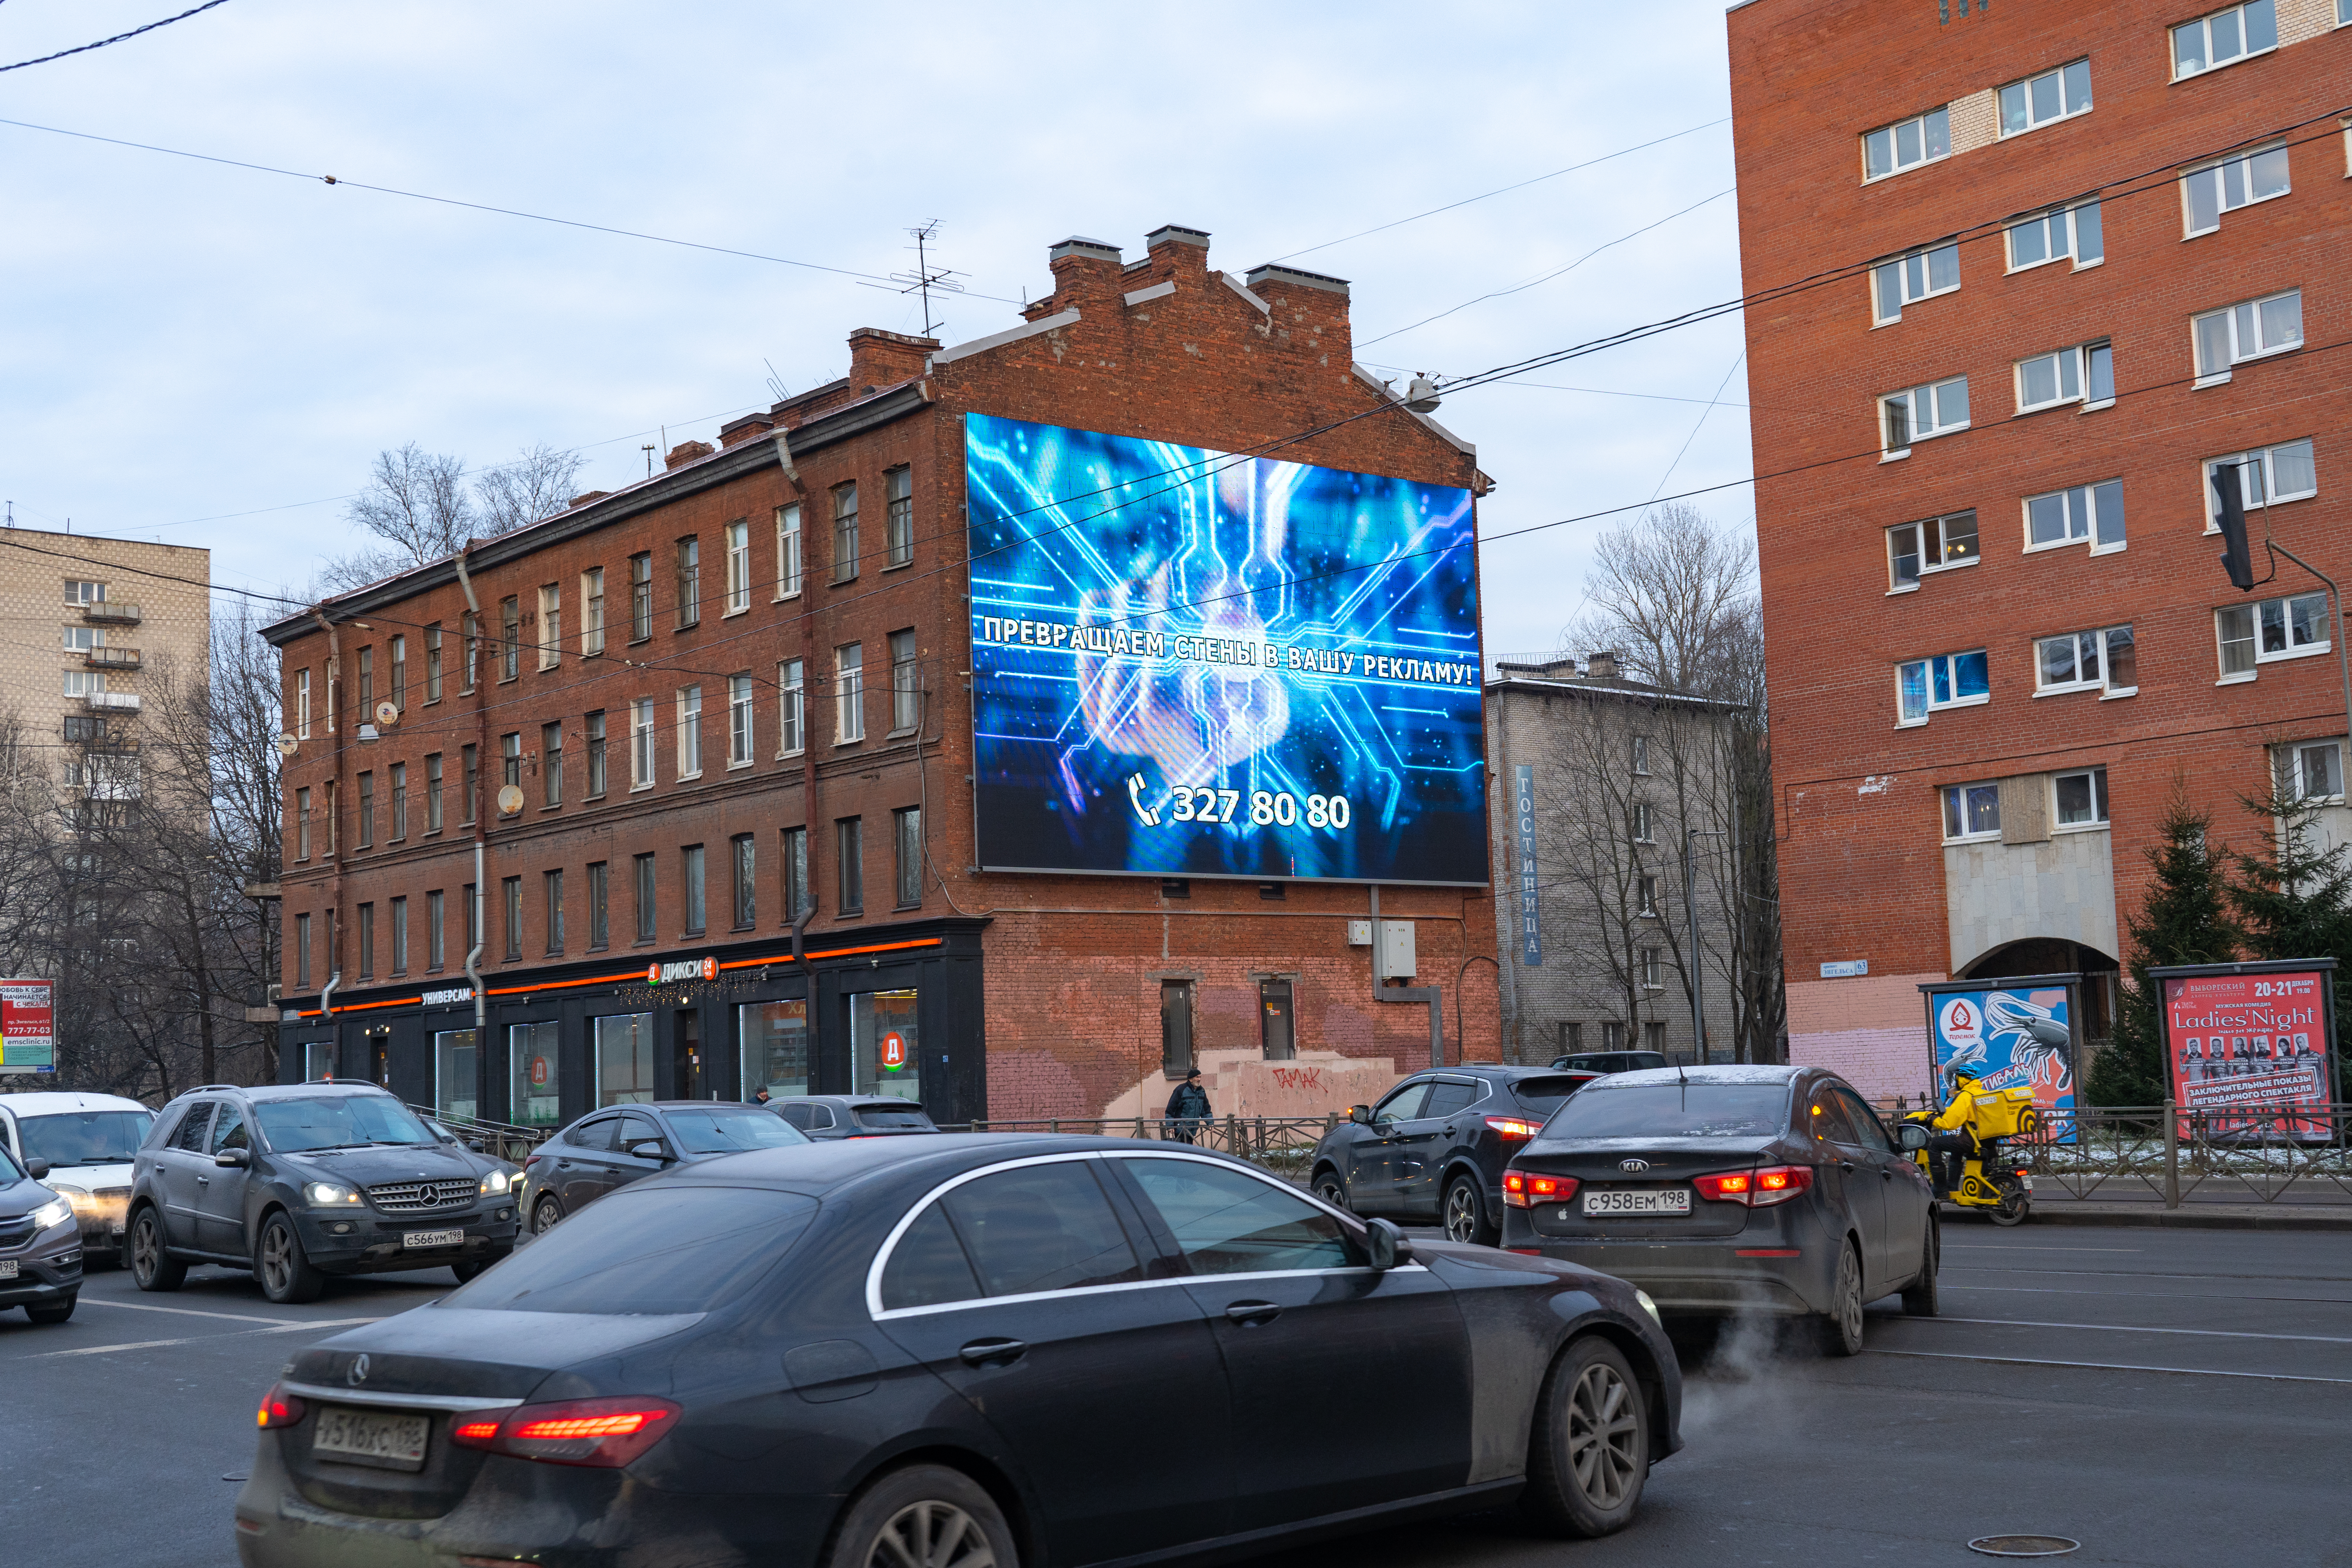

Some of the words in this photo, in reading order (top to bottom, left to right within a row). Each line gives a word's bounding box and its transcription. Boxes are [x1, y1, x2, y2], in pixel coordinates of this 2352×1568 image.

[984, 616, 1165, 657] ПРЕВРАЩАЕМ
[1174, 635, 1256, 666] СТЕНЫ
[1265, 644, 1278, 667] В
[1288, 646, 1355, 674] ВАШУ
[1363, 653, 1472, 686] РЕКЛАМУ!
[1172, 786, 1240, 823] 327
[1251, 790, 1296, 826] 80
[1307, 793, 1350, 829] 80
[1520, 778, 1537, 952] ГОСТИНИЦА
[649, 967, 655, 979] Д
[661, 960, 702, 983] ДИКСИ
[704, 960, 712, 969] 24
[422, 988, 470, 1005] УНИВЕРСАМ
[2190, 982, 2245, 992] ВЫБОРГСКИЙ
[2254, 981, 2292, 996] 20-21
[2252, 1007, 2315, 1031] Night
[888, 1039, 898, 1061] Д
[536, 1063, 543, 1080] Д
[1272, 1066, 1328, 1093] ГАМАК
[2189, 1080, 2272, 1096] ЗАКЛЮЧИТЕЛЬНЫЕ
[2273, 1074, 2312, 1086] ПОКАЗЫ
[2192, 1091, 2260, 1106] ЛЕГЕНДАРНОГО
[2260, 1084, 2312, 1097] СПЕКТАКЛЯ
[1623, 1162, 1644, 1171] KIA
[1589, 1193, 1656, 1210] С958ЕМ
[1660, 1192, 1684, 1204] 198
[407, 1233, 446, 1245] С566УМ
[448, 1230, 461, 1239] 198
[0, 1261, 15, 1271] 198
